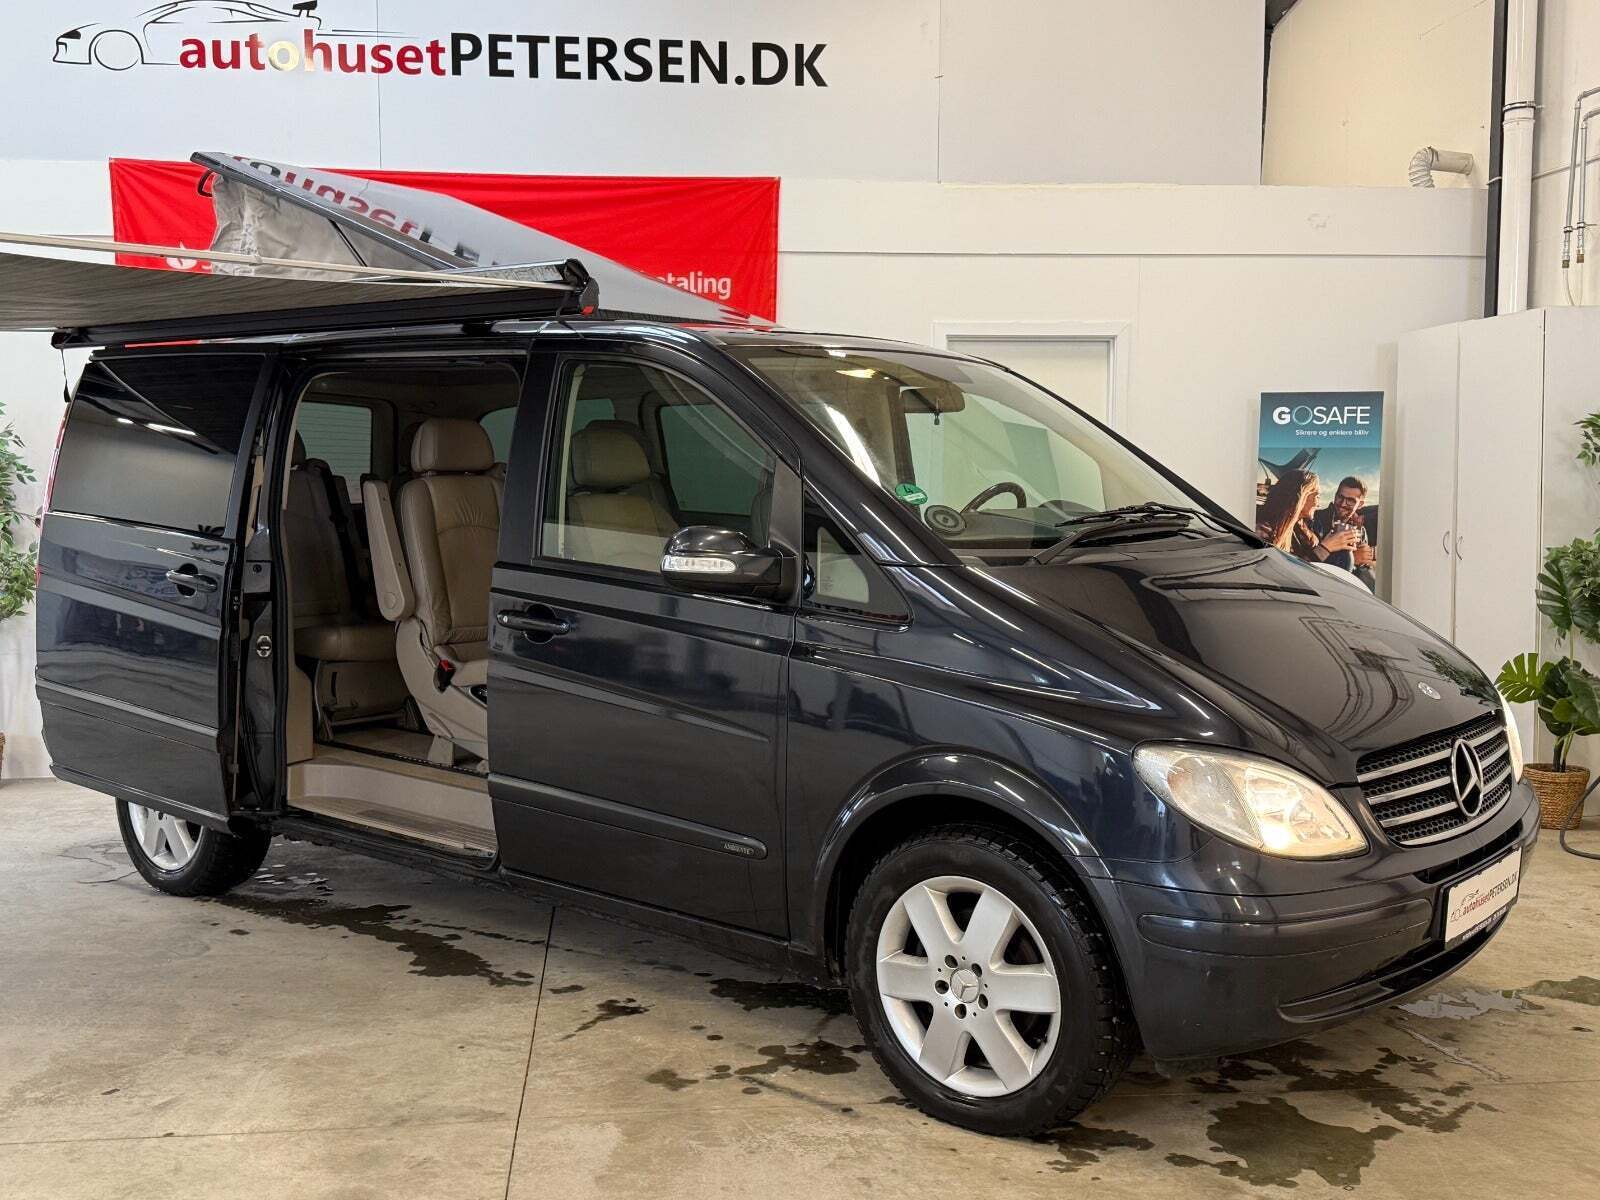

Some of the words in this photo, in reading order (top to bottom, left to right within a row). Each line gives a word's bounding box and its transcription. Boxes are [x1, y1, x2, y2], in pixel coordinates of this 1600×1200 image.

[180, 29, 829, 88] autohusetPETERSEN.DK
[640, 270, 732, 300] taling
[1272, 405, 1371, 425] GOSAFE
